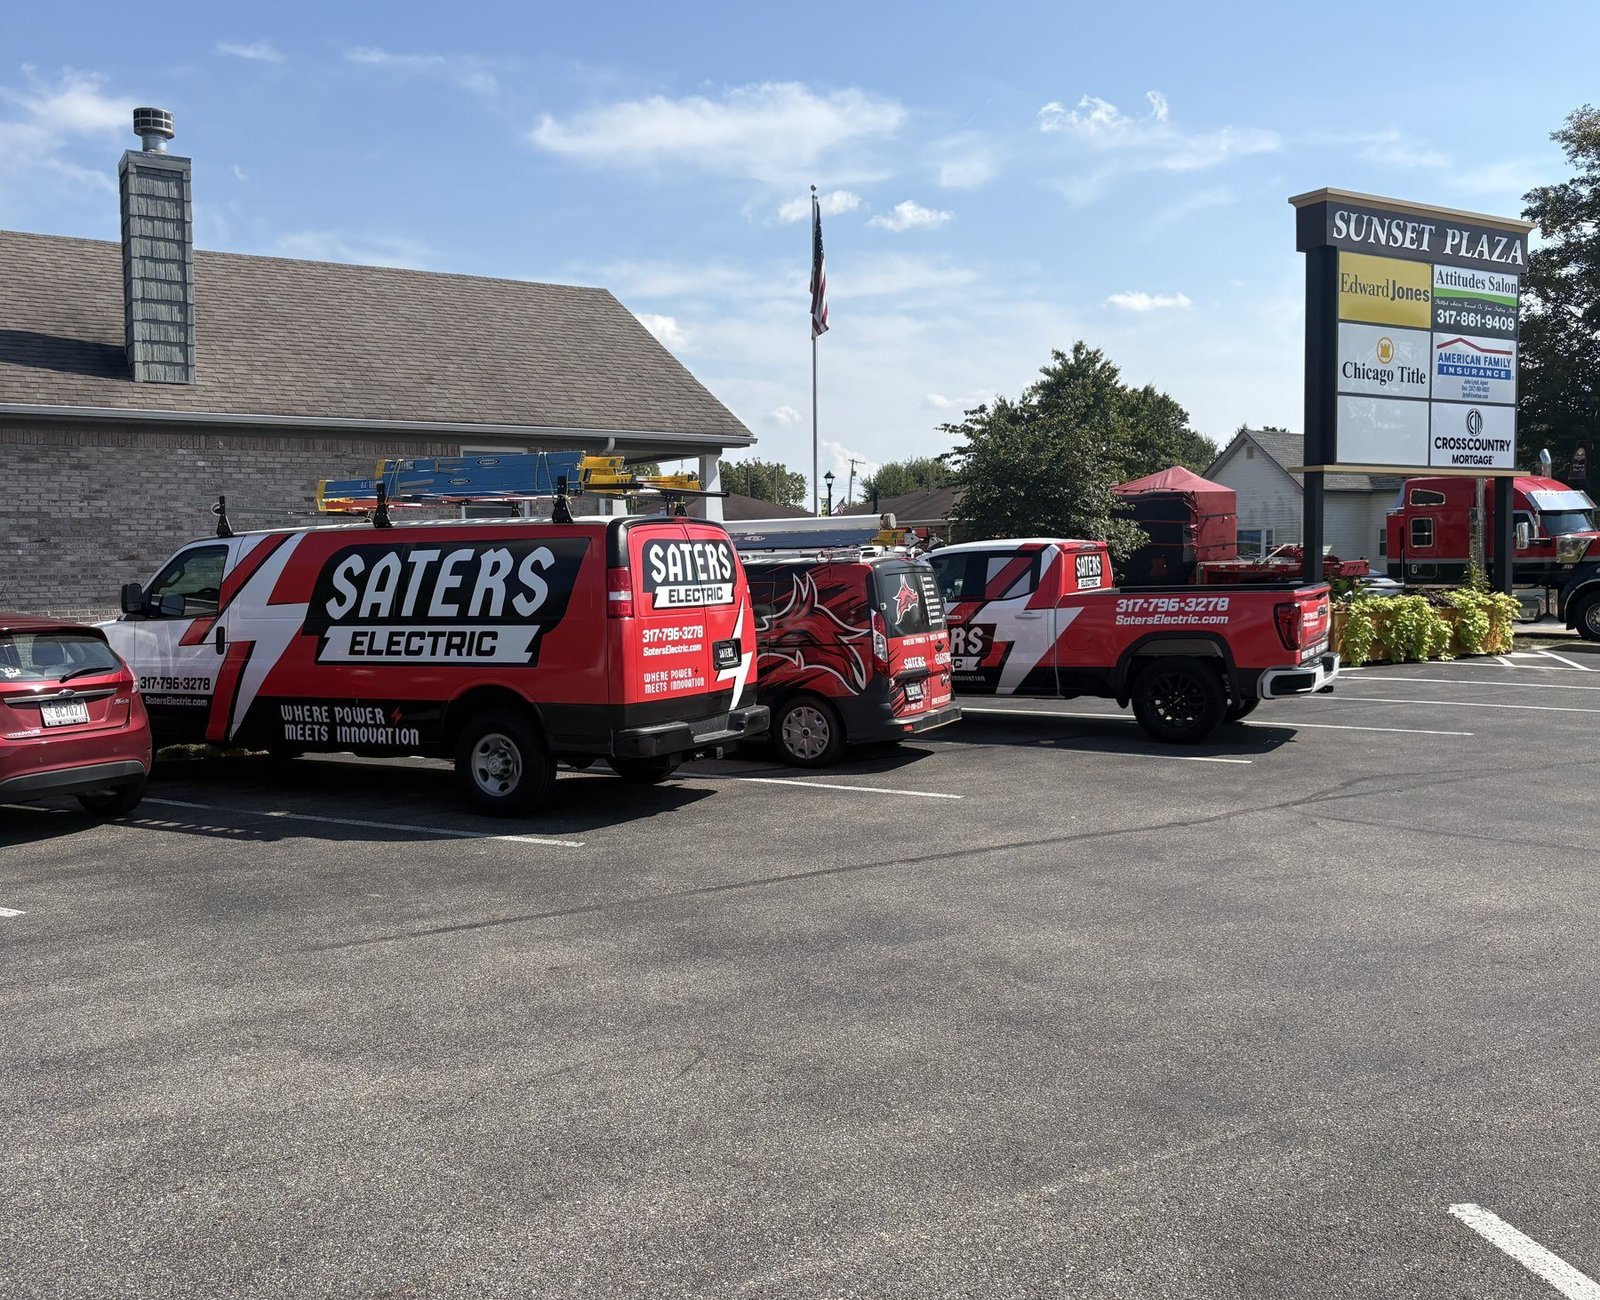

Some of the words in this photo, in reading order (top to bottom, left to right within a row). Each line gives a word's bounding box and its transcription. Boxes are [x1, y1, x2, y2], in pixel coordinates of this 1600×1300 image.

[1332, 210, 1436, 252] SUNSET
[1442, 228, 1524, 266] PLAZA
[1435, 269, 1486, 291] Attitudes
[1488, 275, 1517, 294] Salon
[1437, 308, 1515, 332] 317-861-9409
[1437, 352, 1481, 366] AMERICAN
[1483, 356, 1512, 368] FAMILY
[1342, 361, 1394, 386] Chicago
[1397, 366, 1426, 385] Title
[1443, 366, 1506, 378] INSURANCE
[1434, 436, 1512, 452] CROSSCOUNTRY
[1451, 454, 1493, 465] MORTGAGE
[649, 543, 732, 584] SATERS
[1075, 555, 1101, 577] SATERS
[325, 546, 556, 620] SATERS
[668, 586, 723, 604] ELECTRIC
[1115, 614, 1229, 625] SatersElectric.com
[348, 630, 499, 657] ELECTRIC
[643, 644, 702, 657] SatersElectric.com
[903, 656, 927, 670] SATERS
[643, 670, 669, 683] WHERE
[670, 668, 693, 680] POWER
[644, 681, 668, 694] MEETS
[670, 677, 705, 691] INNOVATION
[145, 695, 208, 707] SatersElectric.com
[280, 704, 331, 722] WHERE
[333, 706, 386, 725] POWER
[284, 724, 329, 741] MEETS
[336, 726, 420, 746] INNOVATION
